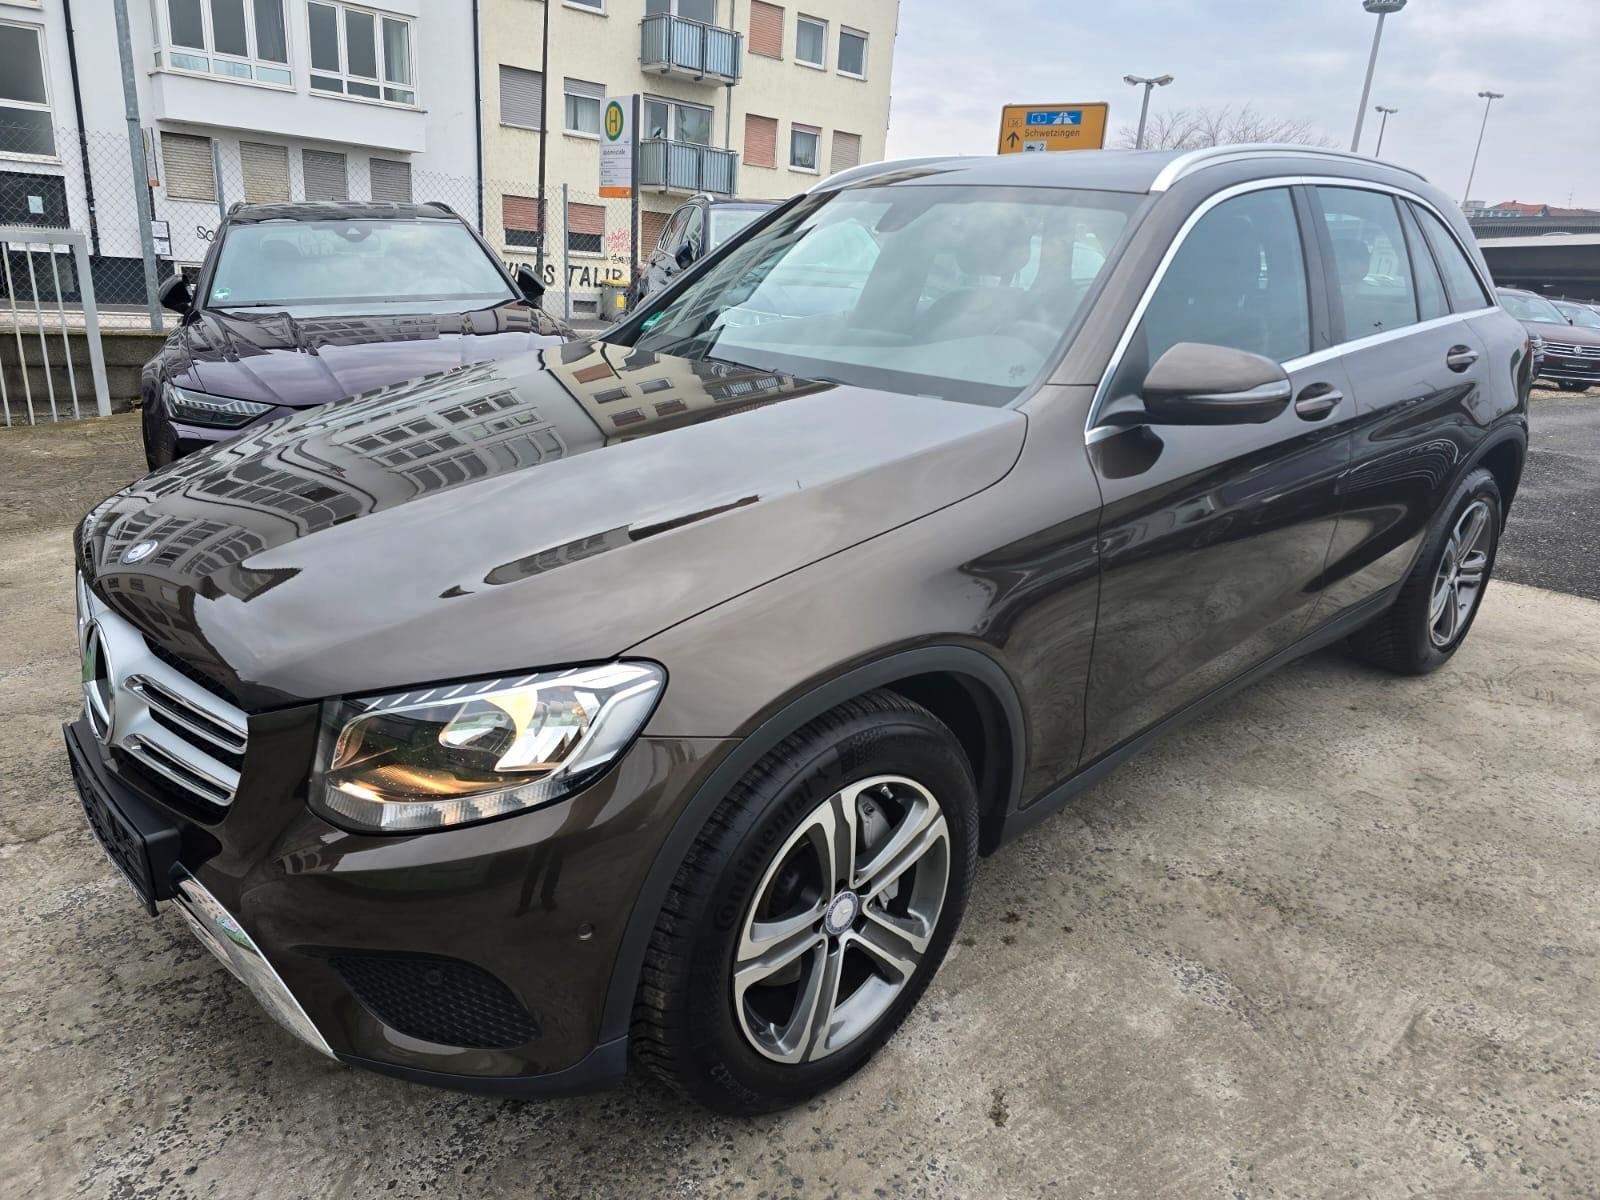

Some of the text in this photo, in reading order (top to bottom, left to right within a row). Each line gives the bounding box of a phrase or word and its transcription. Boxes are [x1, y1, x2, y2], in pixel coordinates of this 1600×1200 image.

[609, 110, 618, 132] H
[1025, 128, 1081, 138] Schwetzingen
[1039, 143, 1045, 151] 2
